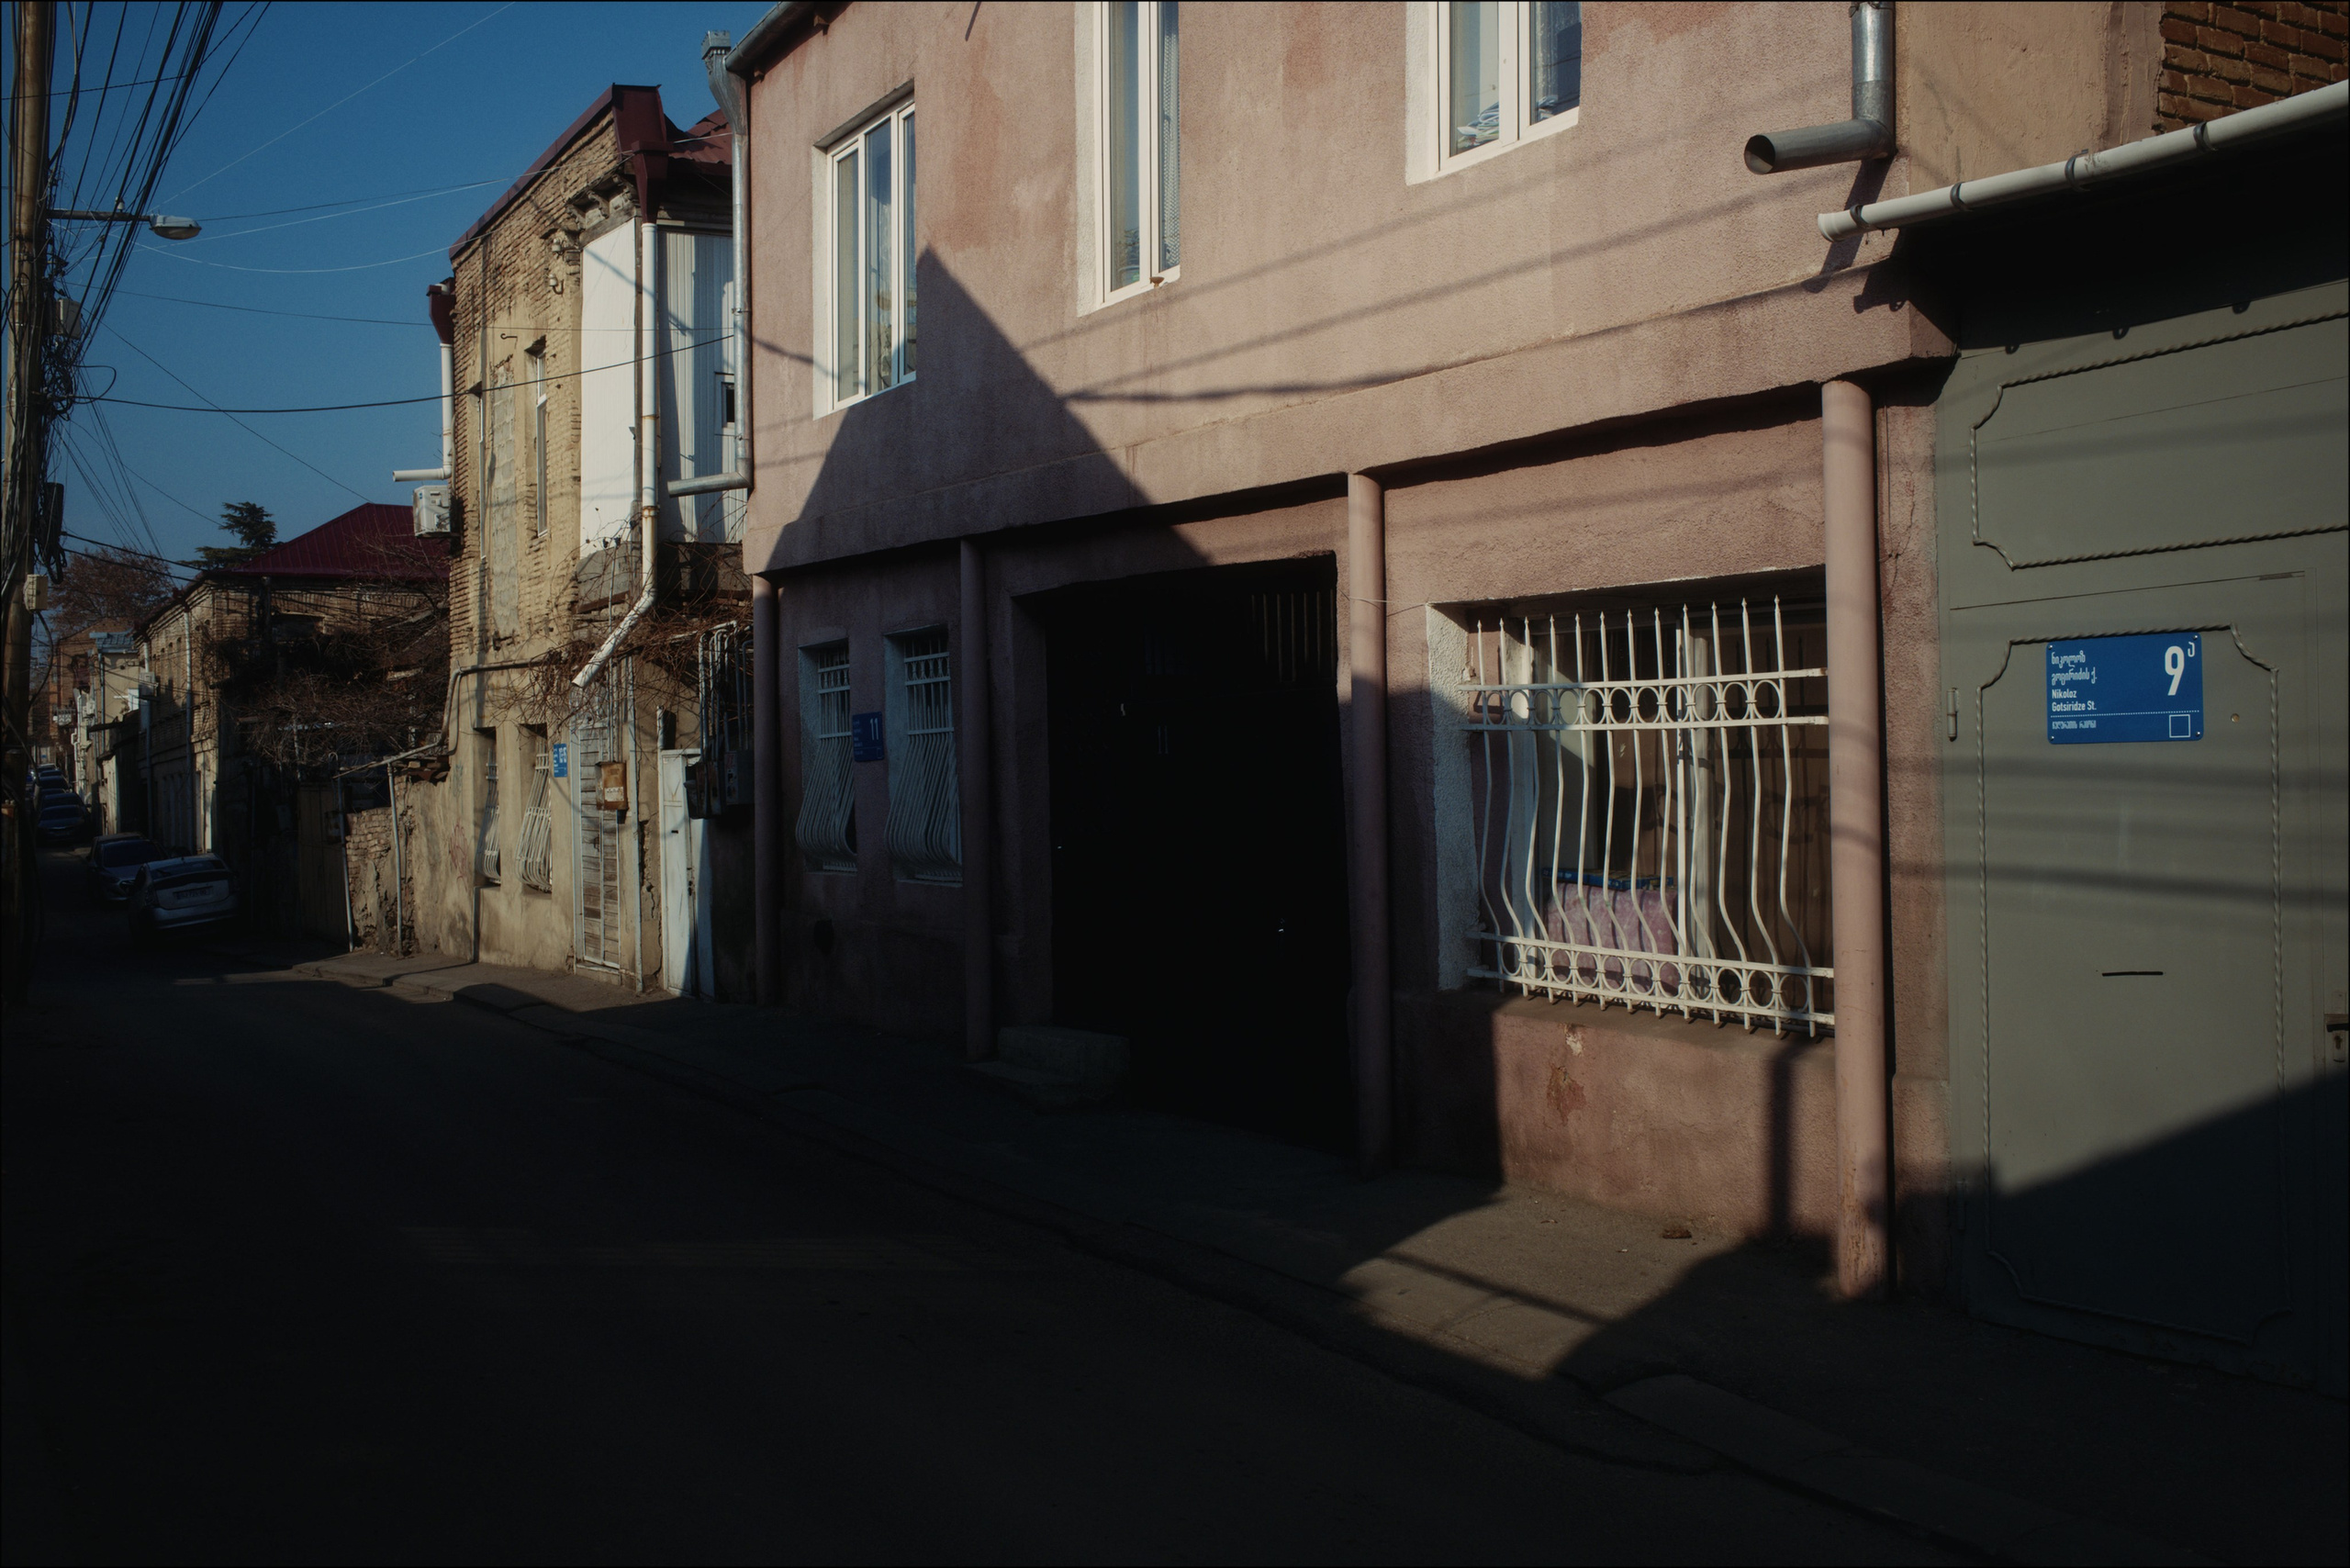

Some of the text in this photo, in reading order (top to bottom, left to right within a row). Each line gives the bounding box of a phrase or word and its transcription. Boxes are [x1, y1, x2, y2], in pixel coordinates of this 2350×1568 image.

[2051, 650, 2086, 668] ნიკოლოზ
[2051, 667, 2090, 686] გოცირიძის
[2052, 689, 2077, 699] Nikoloz
[2052, 700, 2097, 711] Gotsiridze St.
[869, 717, 879, 741] 11
